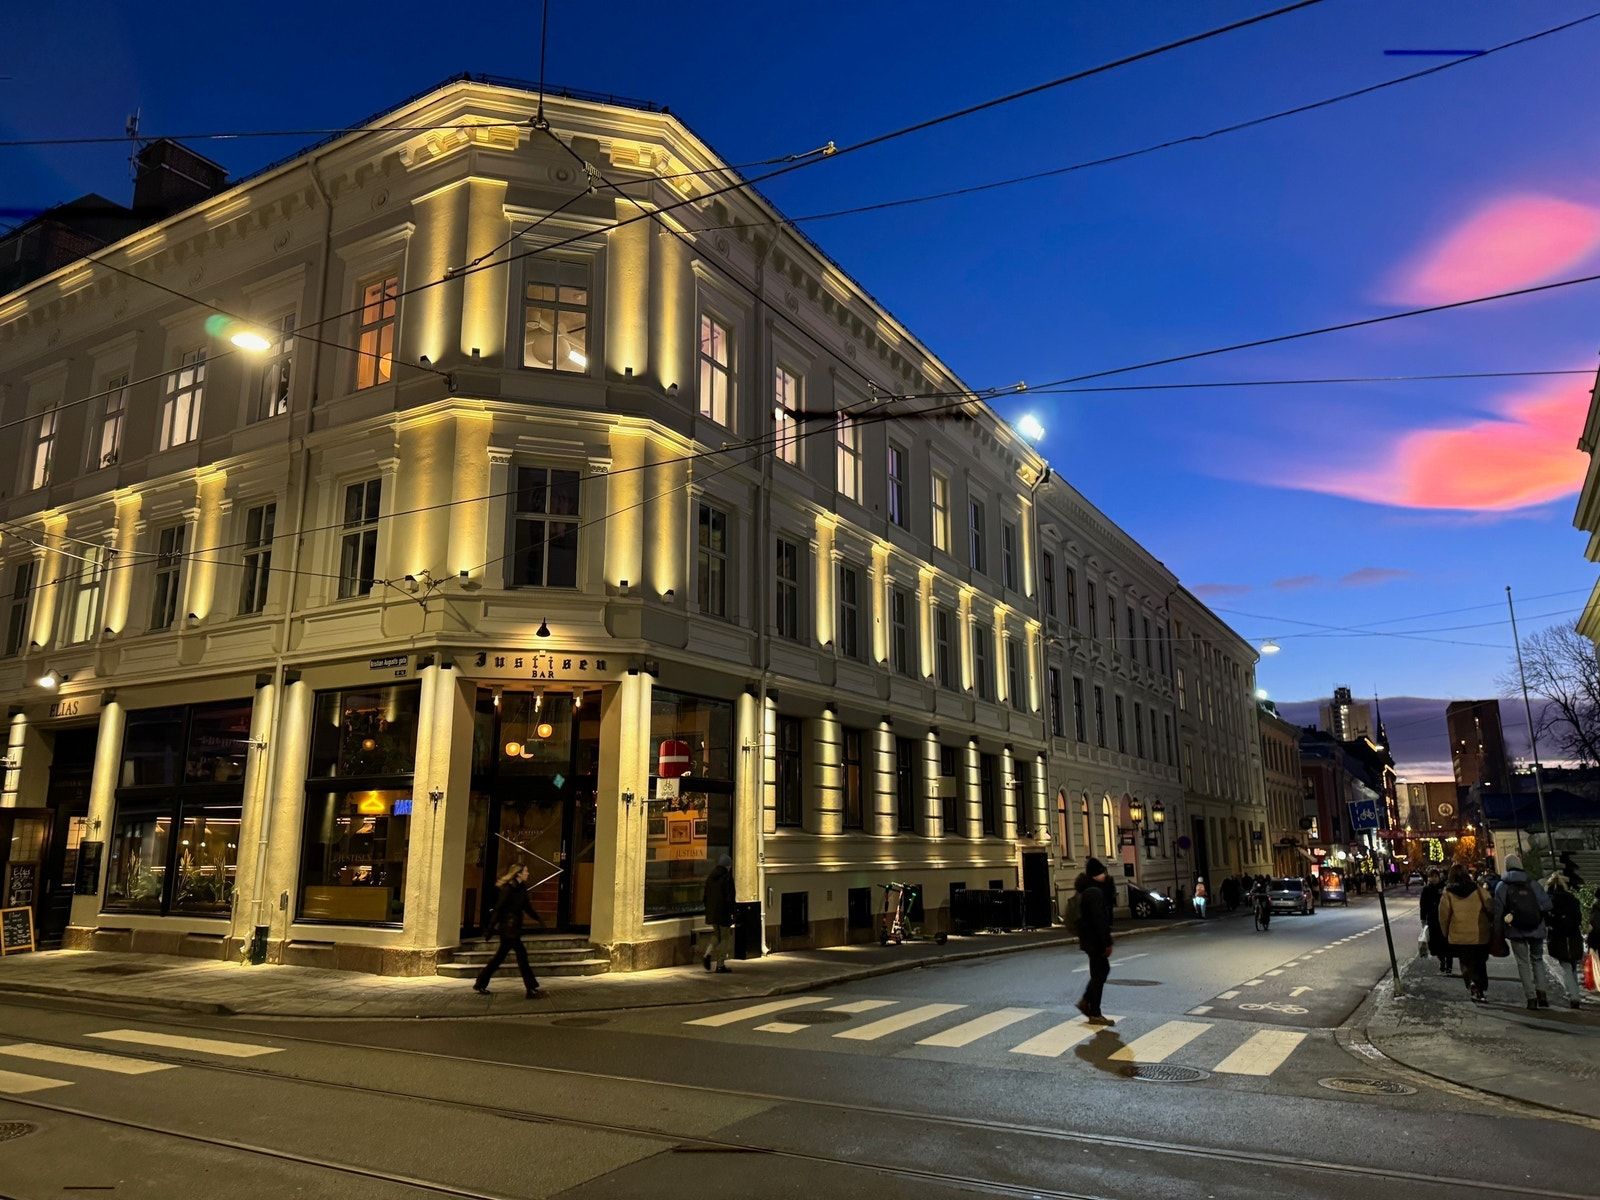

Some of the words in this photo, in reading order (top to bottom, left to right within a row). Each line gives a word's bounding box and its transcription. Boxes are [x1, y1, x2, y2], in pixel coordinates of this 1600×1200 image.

[474, 651, 607, 671] Justisen
[532, 670, 554, 679] BAR
[50, 700, 79, 718] ELIAS
